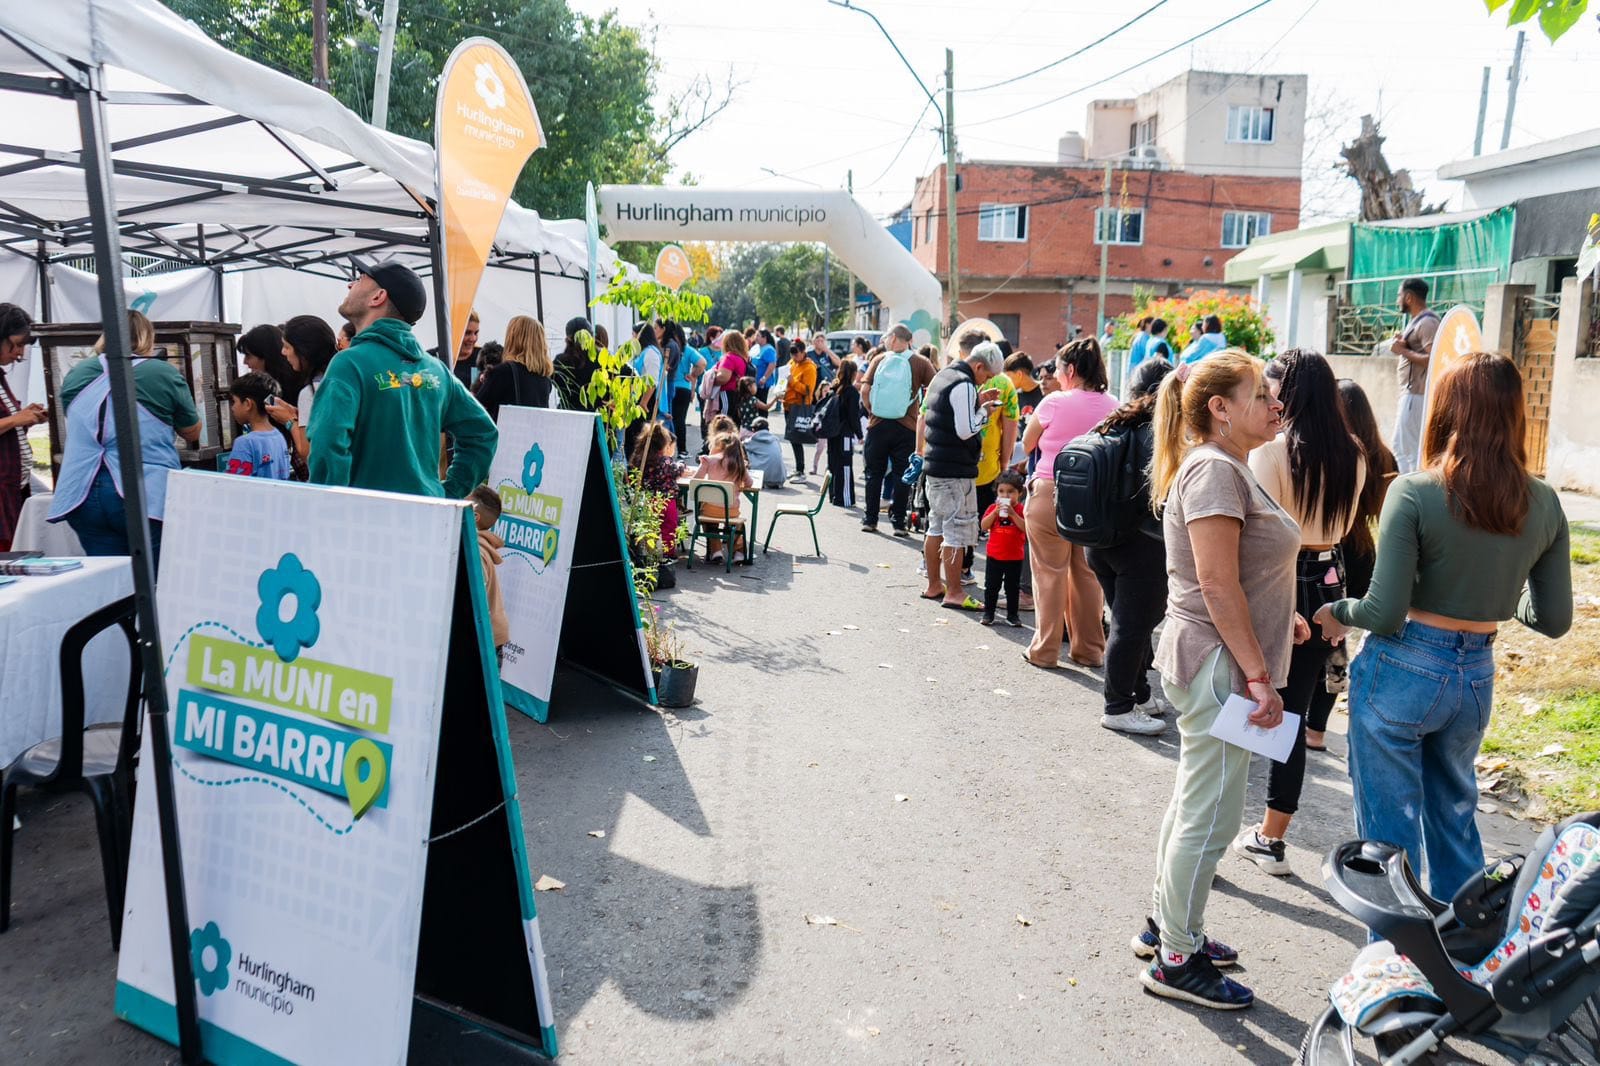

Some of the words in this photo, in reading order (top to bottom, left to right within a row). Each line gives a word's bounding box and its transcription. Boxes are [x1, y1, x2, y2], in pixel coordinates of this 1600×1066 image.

[456, 101, 525, 139] Hurlingham
[464, 123, 517, 149] municipio
[616, 203, 733, 226] Hurlingham
[739, 205, 826, 226] municipio
[502, 490, 513, 511] La
[514, 494, 544, 518] MUNI
[545, 505, 557, 521] en
[201, 646, 236, 689] La
[243, 655, 333, 713] MUNI
[338, 687, 378, 725] en
[184, 701, 226, 751] MI
[238, 953, 315, 1002] Hurlingham
[235, 978, 294, 1016] municipio
